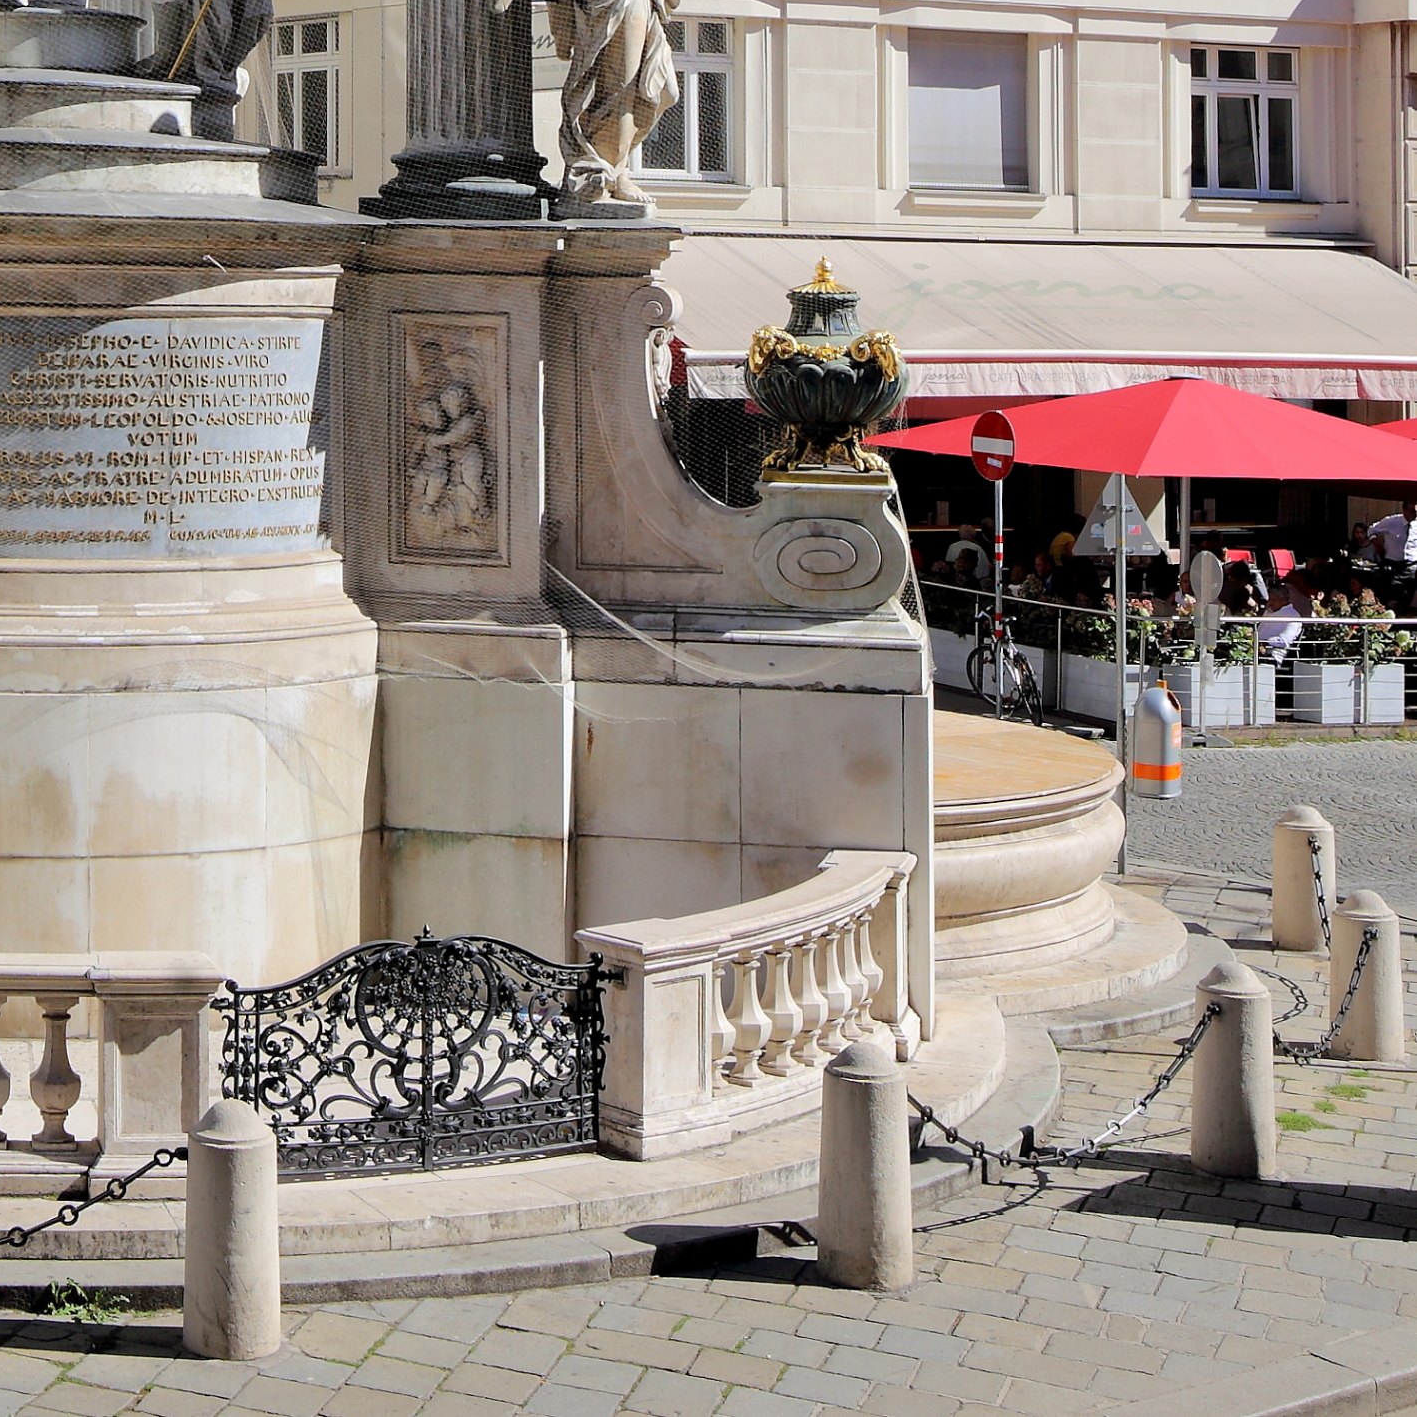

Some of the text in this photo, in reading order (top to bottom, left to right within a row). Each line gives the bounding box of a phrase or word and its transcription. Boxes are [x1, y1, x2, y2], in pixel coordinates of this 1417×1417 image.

[141, 334, 153, 350] E
[167, 334, 249, 351] DAVIDICA
[257, 335, 301, 351] STIRPE
[148, 353, 225, 369] VIRGINIS
[234, 353, 270, 368] VIRO
[96, 372, 209, 389] SERVATORIS
[216, 373, 288, 388] NUTRITIO
[1022, 371, 1074, 383] BRASSERIE
[1079, 372, 1100, 383] BAR
[147, 391, 241, 409] AUSTRIAE
[249, 391, 311, 407] PATRONO
[90, 411, 198, 428] LEOPOLDO
[126, 431, 199, 448] VOTUM
[202, 450, 224, 466] ET
[232, 449, 283, 465] HISPAN
[290, 447, 315, 463] REX
[169, 468, 283, 486] ADUMBRATUM
[289, 466, 320, 480] OPUS
[146, 490, 171, 506] DE
[179, 488, 250, 505] INTEGRO
[257, 484, 326, 503] EXSTRUENS
